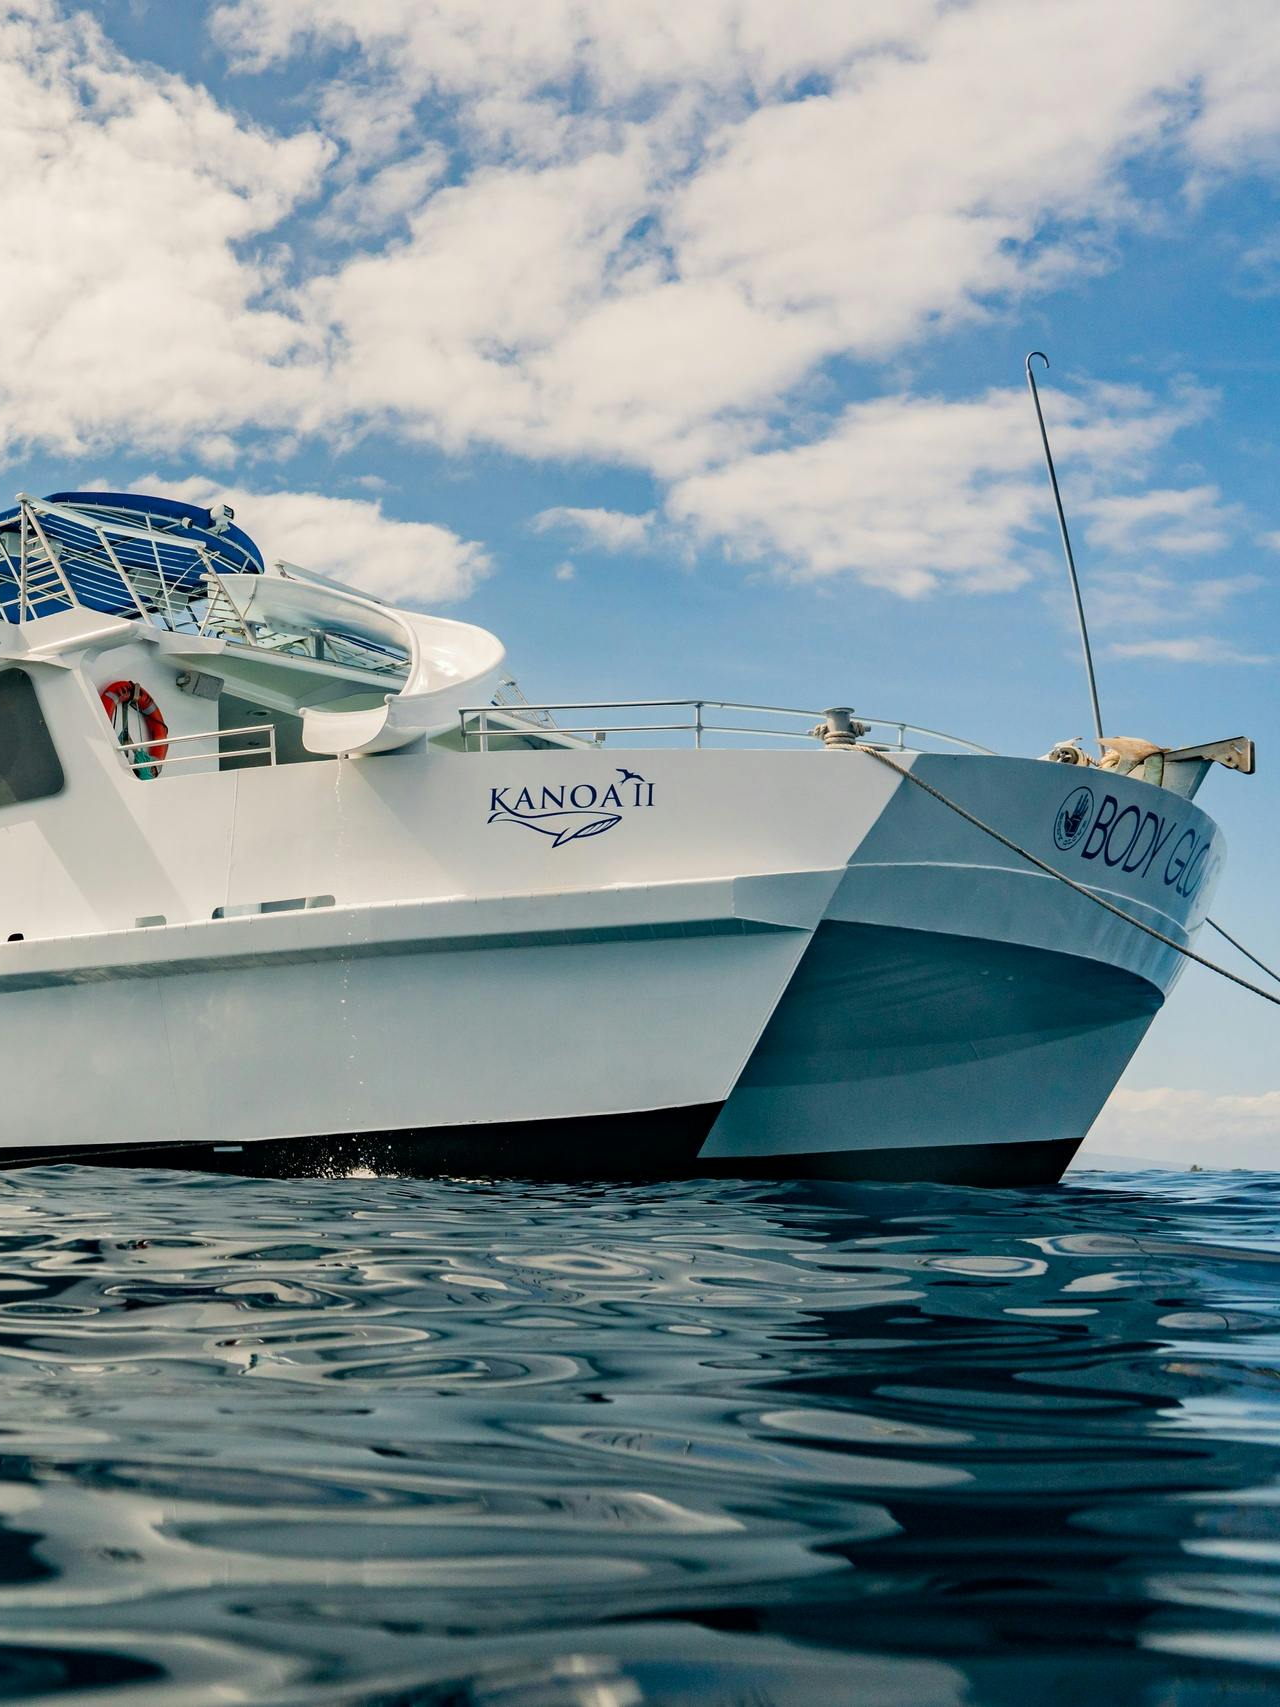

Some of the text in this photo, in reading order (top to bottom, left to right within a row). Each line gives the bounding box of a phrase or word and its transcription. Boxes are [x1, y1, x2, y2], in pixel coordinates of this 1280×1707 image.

[489, 783, 656, 812] KANOA II
[1081, 794, 1177, 879] BODY
[1163, 828, 1213, 899] GLO
